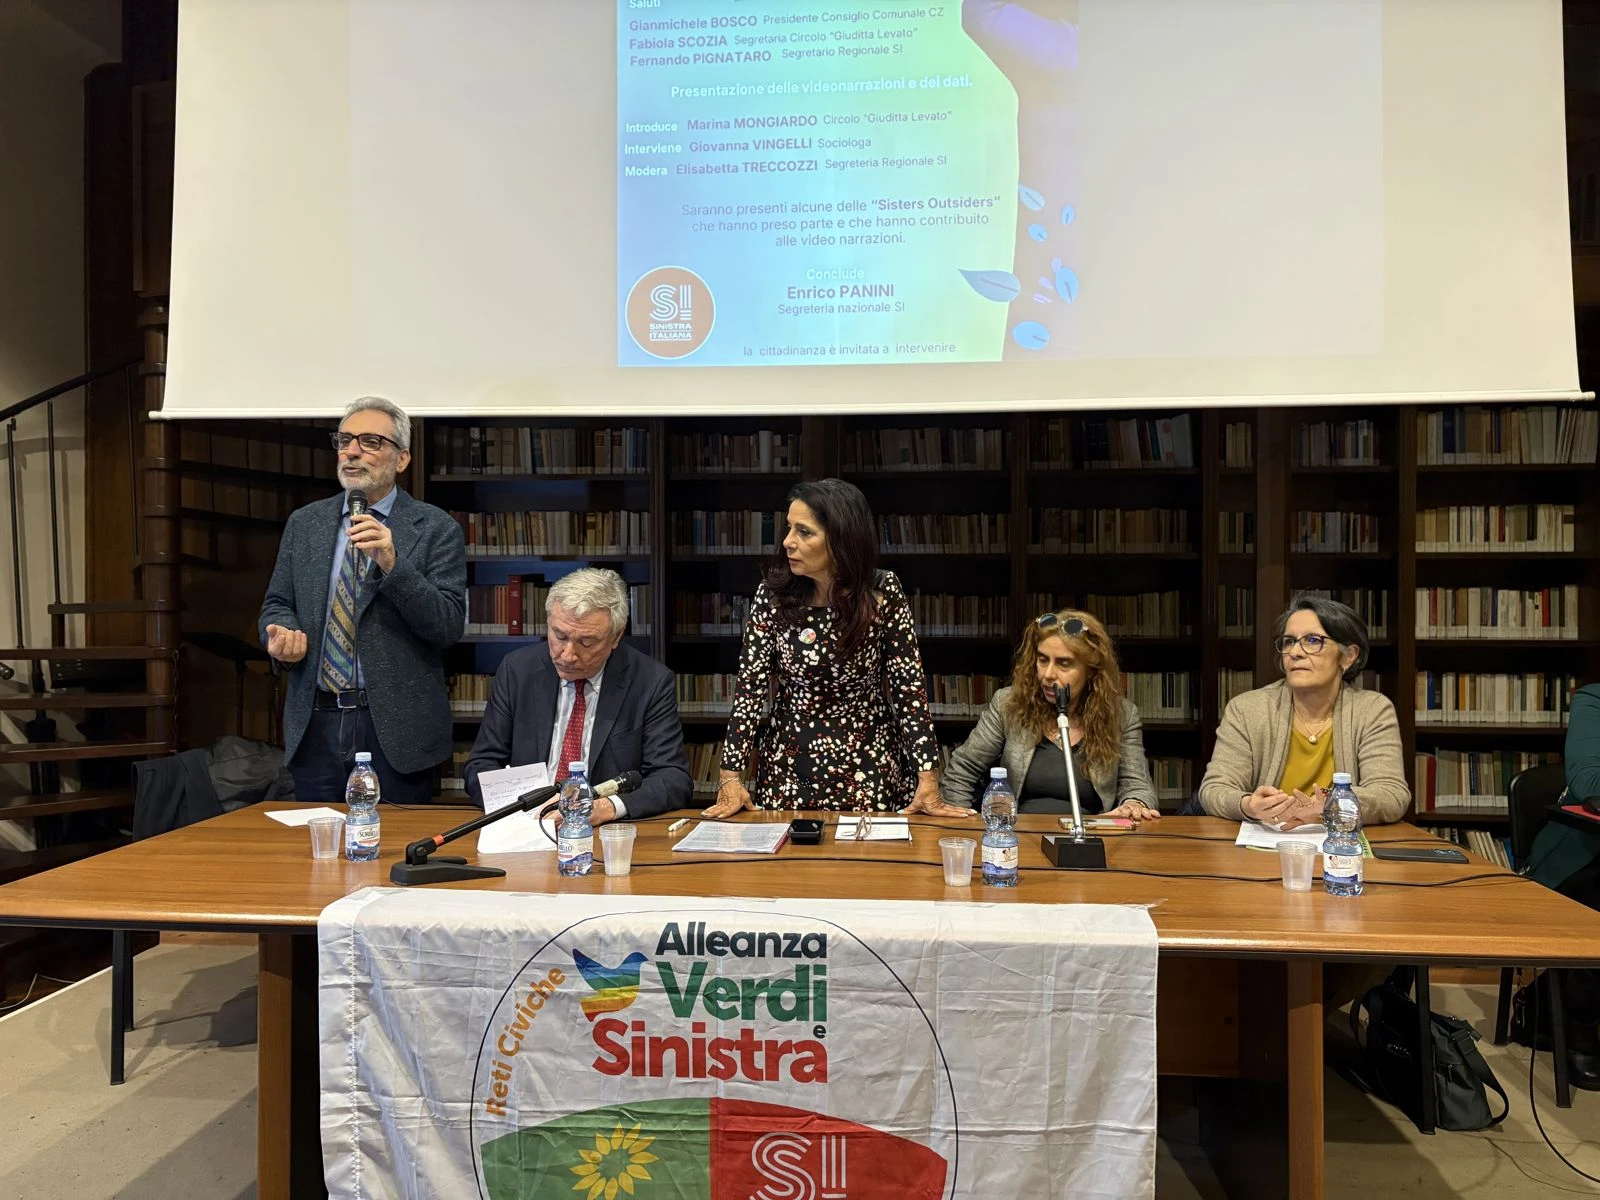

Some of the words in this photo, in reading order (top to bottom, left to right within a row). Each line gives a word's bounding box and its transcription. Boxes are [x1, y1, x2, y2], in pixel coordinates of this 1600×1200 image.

[629, 18, 707, 32] Gianmichele
[711, 15, 757, 28] BOSCO
[763, 13, 818, 25] Presidente
[821, 11, 870, 23] Consiglio
[872, 8, 926, 20] Comunale
[928, 7, 944, 17] CZ
[629, 38, 674, 50] Fabiola
[678, 35, 728, 48] SCOZIA
[734, 33, 787, 46] Segretaria
[789, 32, 827, 43] Circolo
[630, 54, 690, 67] Fernando
[693, 51, 772, 64] PIGNATARO
[782, 47, 835, 60] Segretario
[838, 45, 889, 58] Regionale
[893, 44, 903, 54] SI
[671, 82, 765, 98] Presentazione
[767, 80, 799, 95] delle
[801, 77, 905, 93] videonarrazioni
[908, 79, 917, 89] e
[919, 76, 941, 89] dei
[943, 75, 973, 88] dati.
[626, 122, 678, 133] Introduce
[687, 118, 730, 131] Marina
[734, 115, 817, 129] MONGIARDO
[823, 114, 860, 125] Circolo
[624, 143, 682, 155] Interviene
[689, 141, 749, 152] Giovanna
[752, 138, 812, 150] VINGELLI
[817, 137, 872, 149] Sociologa
[625, 165, 668, 177] Modera
[676, 162, 739, 175] Elisabetta
[742, 160, 818, 172] TRECCOZZI
[825, 158, 879, 171] Segreteria
[882, 156, 934, 168] Regionale
[937, 155, 947, 165] SI
[682, 204, 733, 216] Saranno
[737, 202, 787, 216] presenti
[791, 201, 833, 213] alcune
[837, 200, 867, 212] delle
[692, 221, 715, 232] che
[718, 220, 757, 231] hanno
[761, 220, 796, 232] preso
[801, 219, 833, 231] parte
[837, 219, 845, 228] e
[849, 216, 872, 228] che
[876, 216, 916, 227] hanno
[919, 213, 989, 226] contribuito
[776, 235, 797, 247] alle
[801, 234, 835, 246] video
[839, 232, 906, 245] narrazioni.
[806, 268, 864, 280] Conclude
[787, 285, 836, 299] Enrico
[840, 284, 894, 298] PANINI
[650, 284, 692, 320] SI
[778, 304, 834, 316] Segreteria
[838, 302, 891, 313] nazionale
[894, 301, 905, 312] SI
[744, 346, 753, 356] la
[759, 345, 826, 356] cittadinanza
[829, 344, 836, 355] è
[839, 343, 880, 355] invitata
[882, 346, 889, 354] a
[895, 342, 956, 354] intervenire
[655, 921, 827, 959] Alleanza
[655, 961, 828, 1022] Verdi
[497, 967, 567, 1058] Civiche
[812, 1024, 826, 1039] e
[592, 1018, 828, 1083] Sinistra
[485, 1060, 513, 1116] Reti
